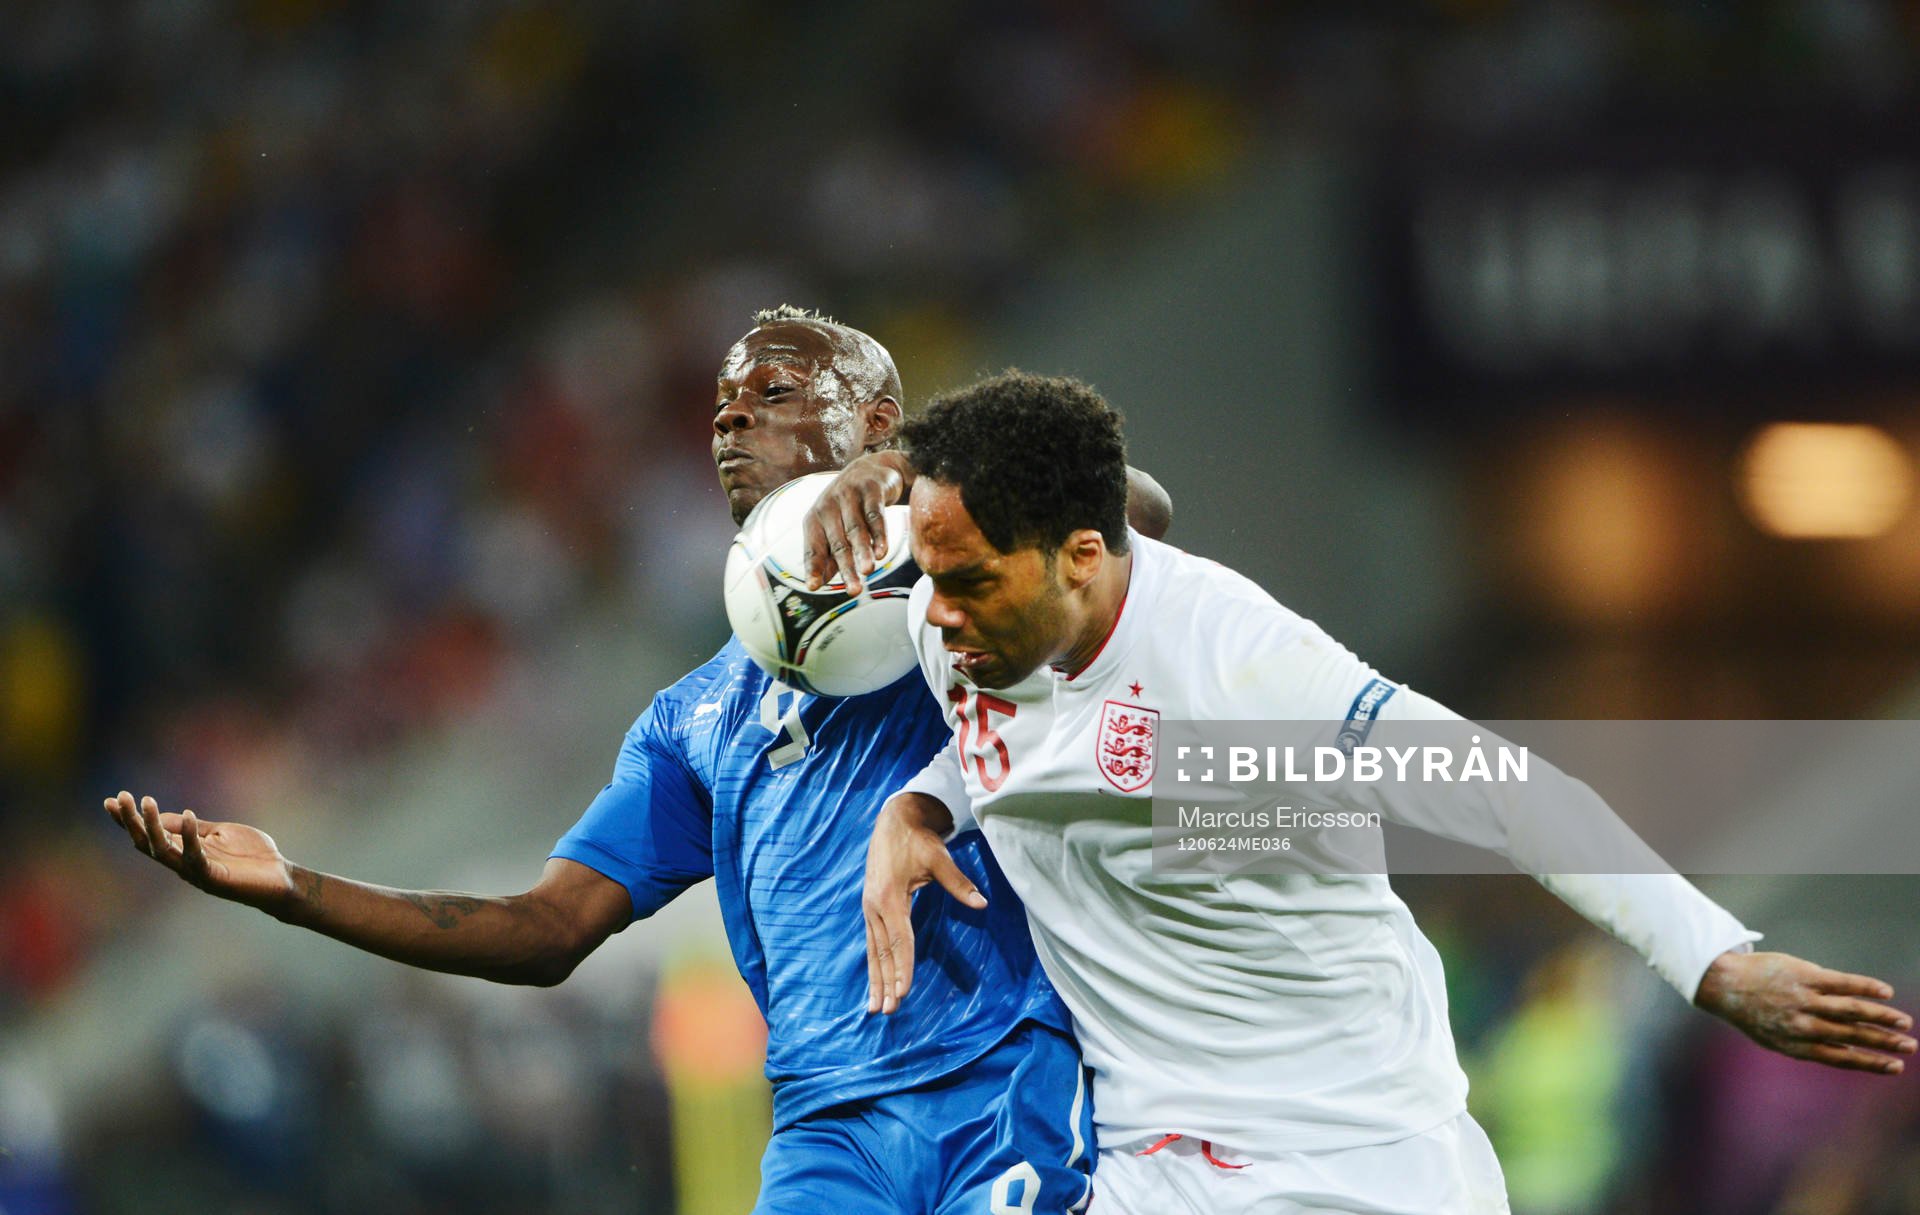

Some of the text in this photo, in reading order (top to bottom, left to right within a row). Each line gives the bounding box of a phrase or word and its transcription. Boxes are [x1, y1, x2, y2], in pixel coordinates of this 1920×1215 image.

[760, 679, 810, 771] 9
[947, 683, 1018, 792] 15
[1349, 682, 1391, 732] RESPECT
